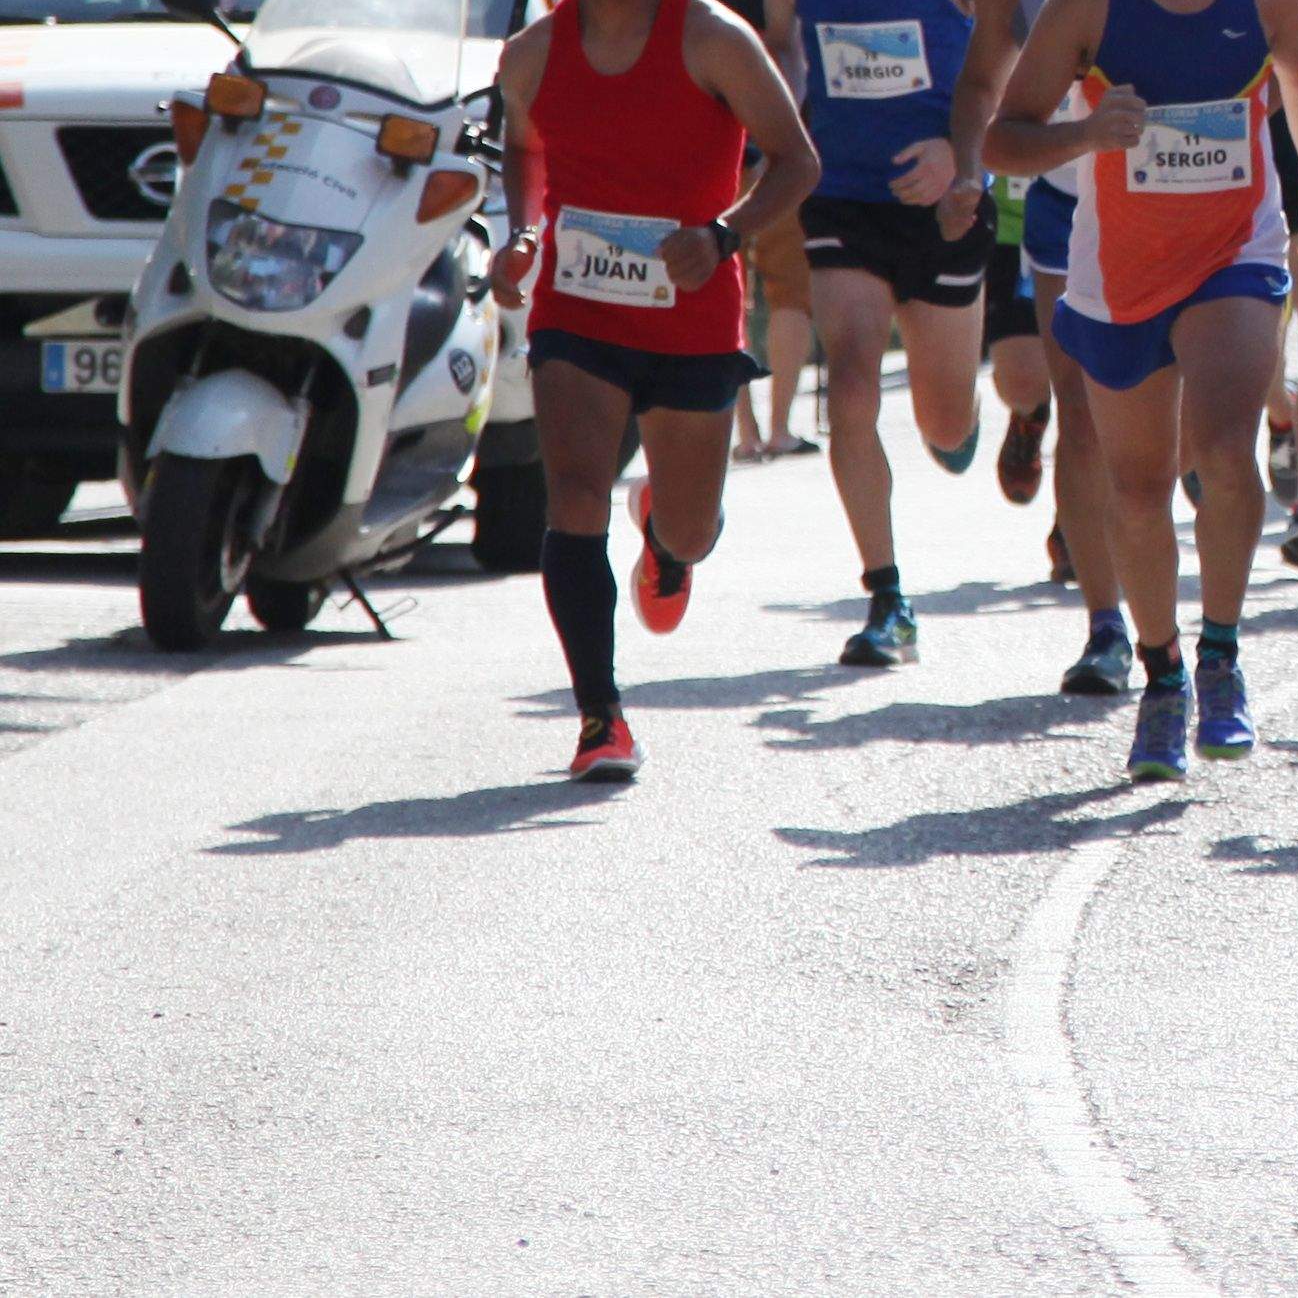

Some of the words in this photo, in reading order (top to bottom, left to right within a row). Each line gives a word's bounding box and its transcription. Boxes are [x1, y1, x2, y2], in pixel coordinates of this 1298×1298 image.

[845, 65, 904, 80] SERGIO
[1184, 133, 1200, 145] 11
[1155, 149, 1228, 168] SERGIO
[581, 254, 648, 282] JUAN
